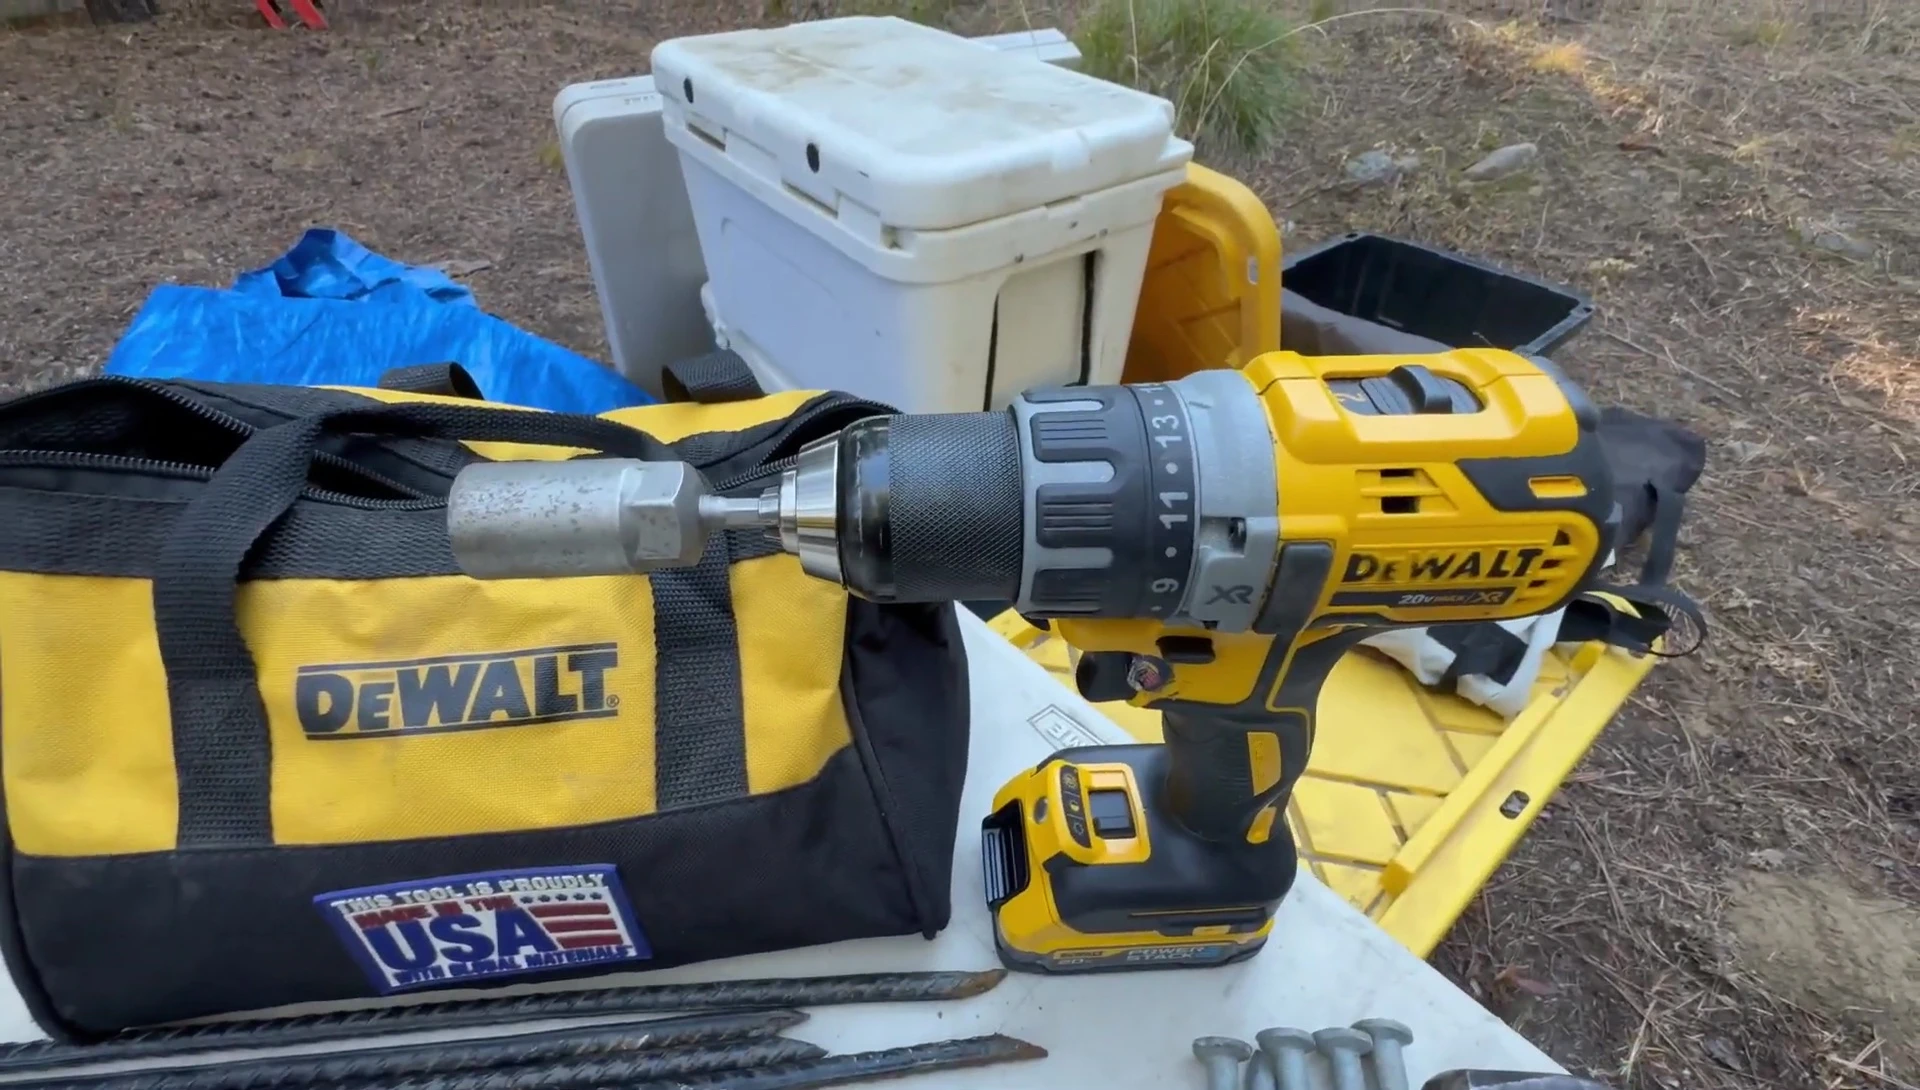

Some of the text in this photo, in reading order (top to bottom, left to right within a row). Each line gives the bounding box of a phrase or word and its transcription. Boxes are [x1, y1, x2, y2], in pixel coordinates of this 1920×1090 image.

[1152, 414, 1183, 448] 13
[1159, 491, 1189, 530] 11
[1342, 548, 1544, 583] DEWALT
[1152, 577, 1179, 593] 9
[1204, 585, 1254, 605] XR
[330, 873, 605, 915] THIS TOOL IS PROUDLY
[361, 905, 560, 971] USA
